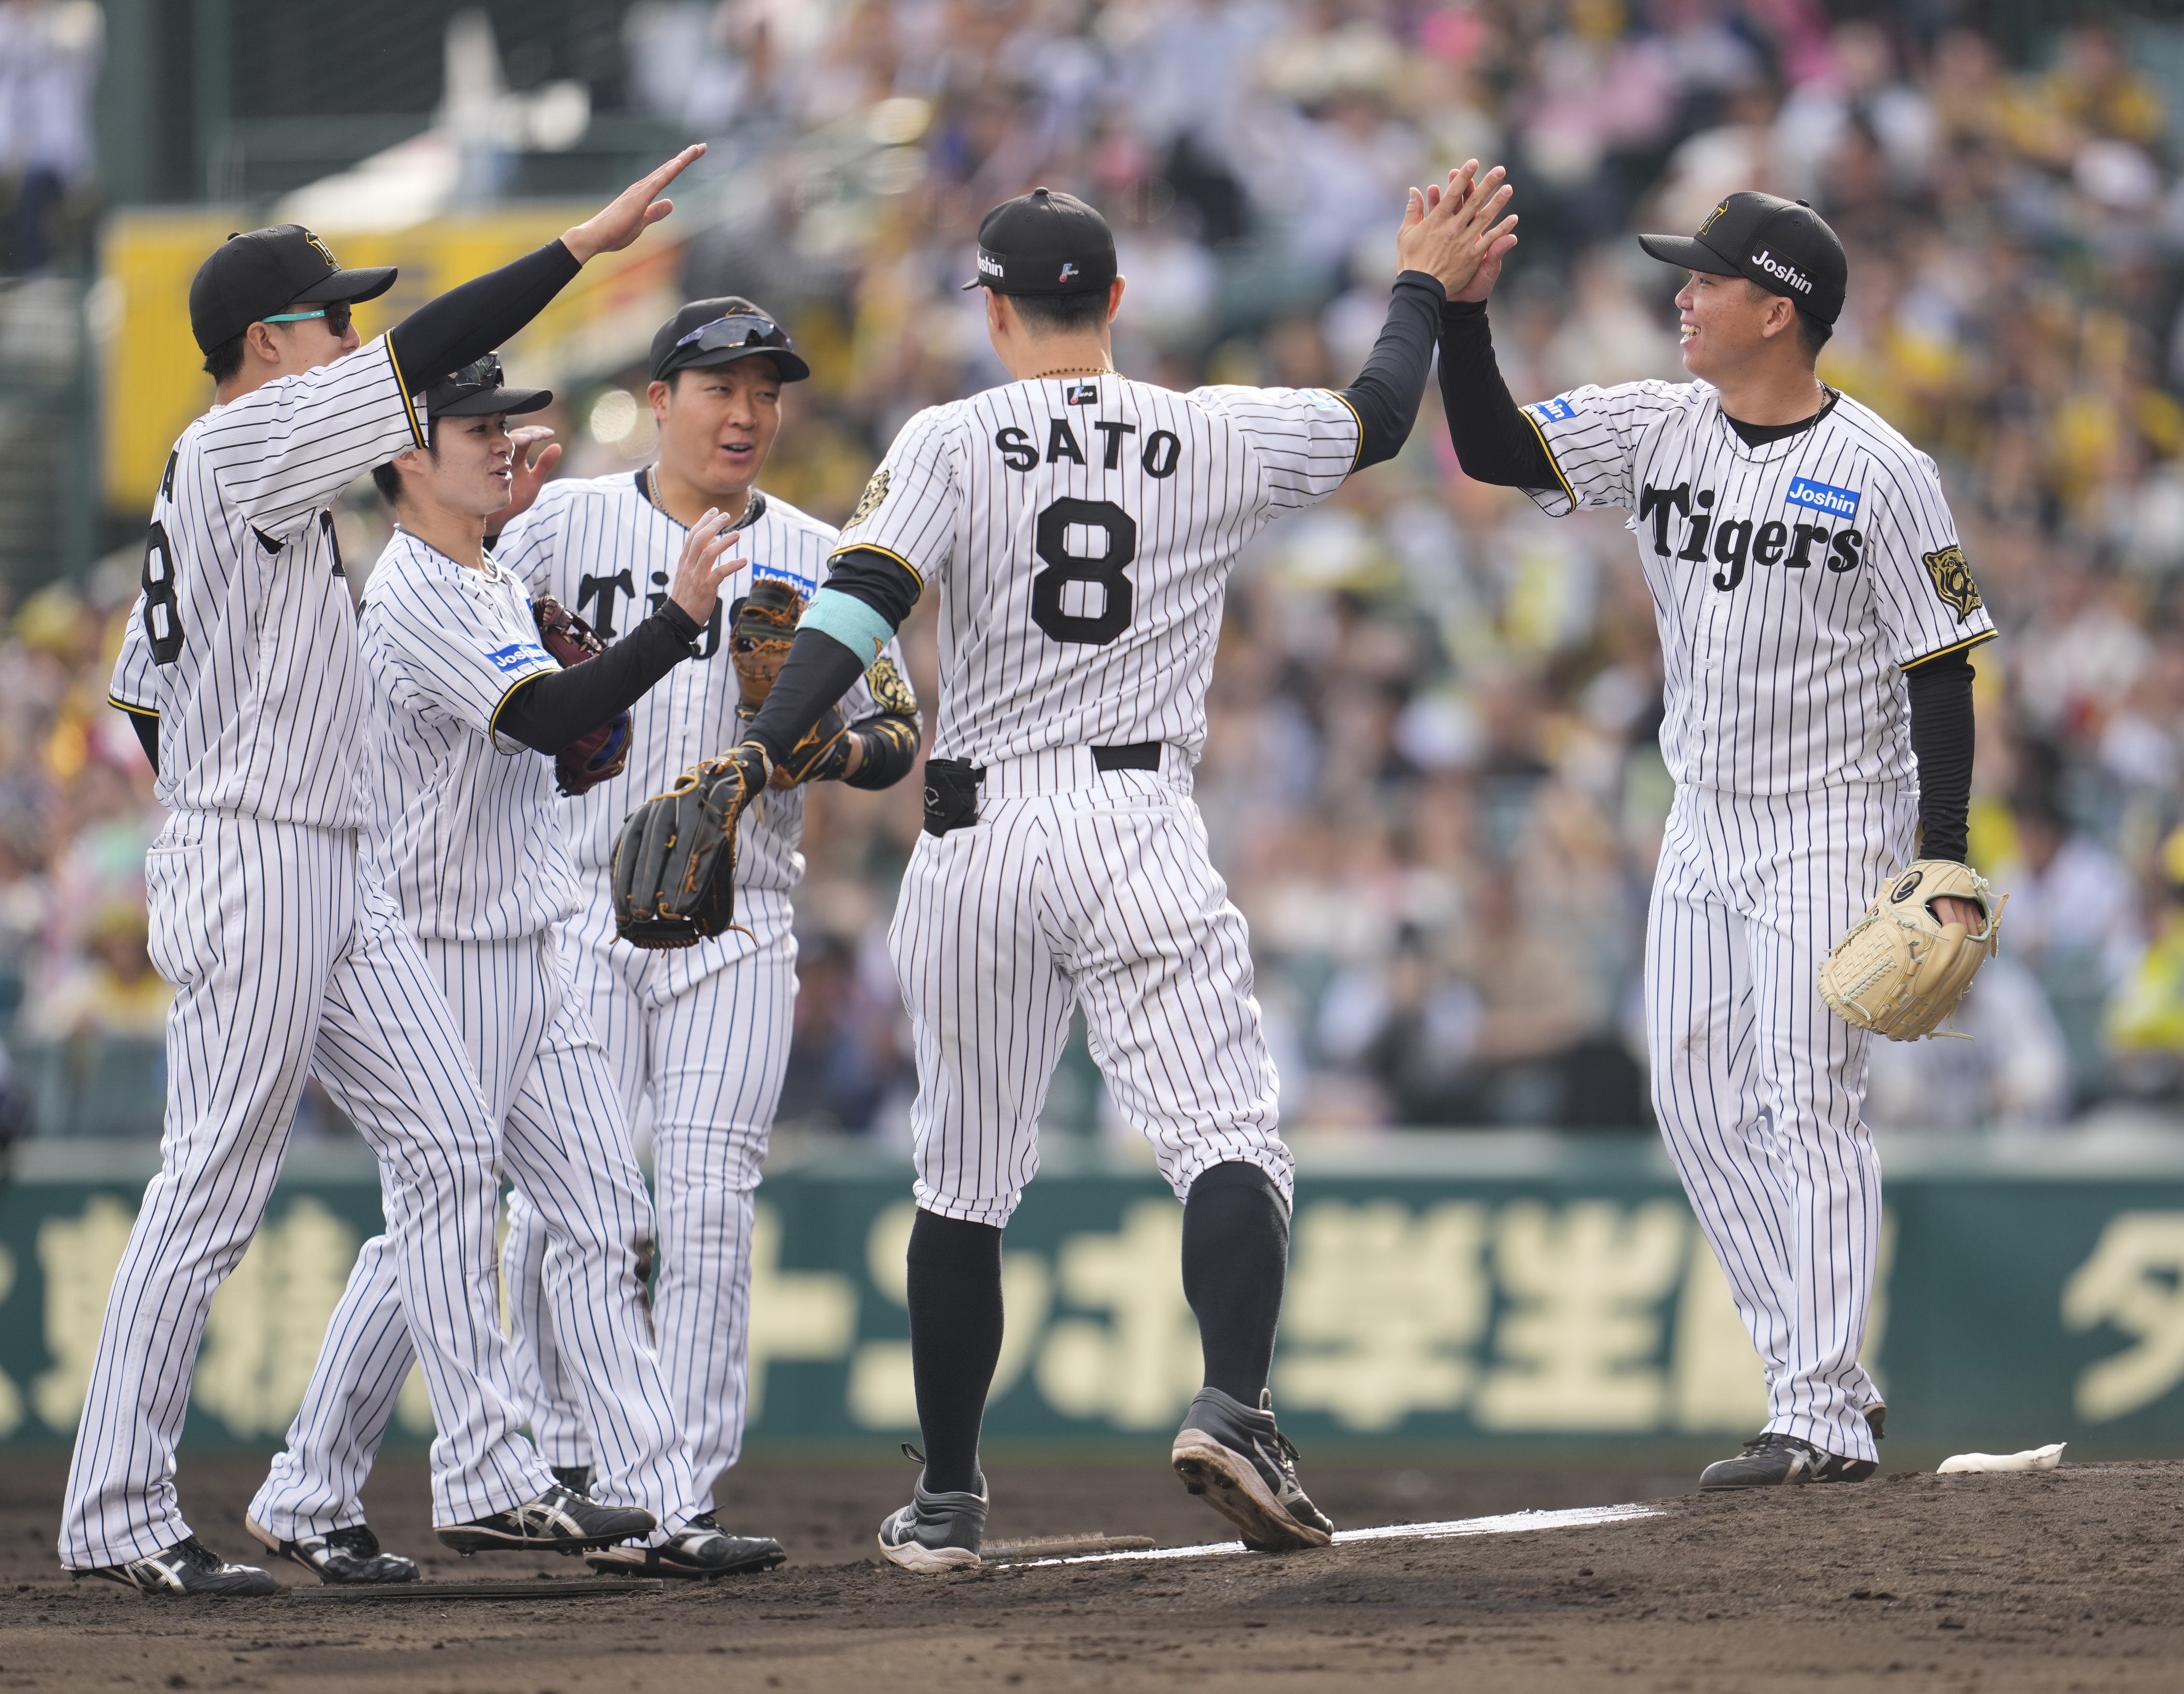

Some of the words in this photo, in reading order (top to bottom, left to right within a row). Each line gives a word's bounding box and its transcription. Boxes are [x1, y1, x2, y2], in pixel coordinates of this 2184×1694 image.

[1752, 250, 1813, 295] Joshin
[995, 418, 1181, 479] SATO
[1789, 483, 1855, 514] Joshin
[1639, 482, 1863, 592] Tigers
[1031, 496, 1136, 646] 8
[577, 568, 749, 661] Tig
[496, 646, 548, 667] Joshin
